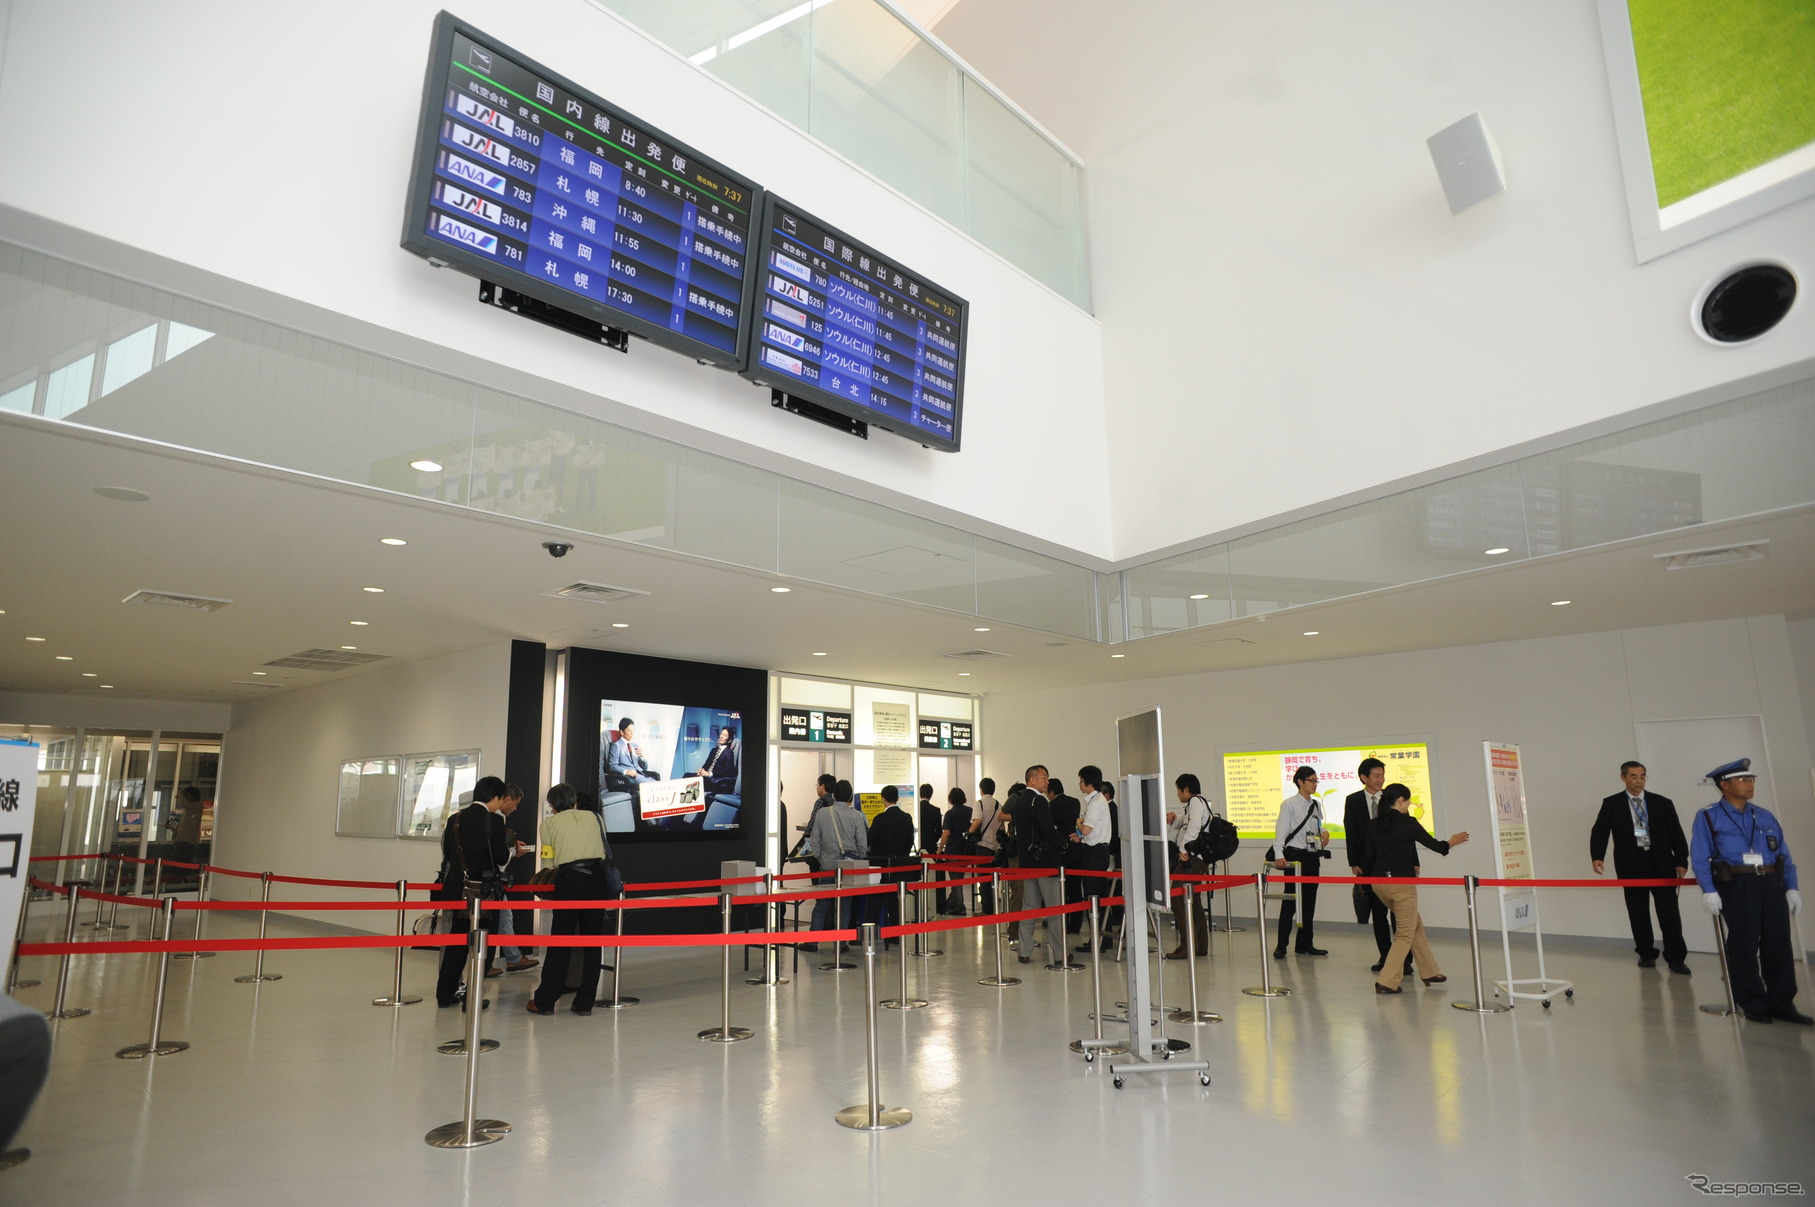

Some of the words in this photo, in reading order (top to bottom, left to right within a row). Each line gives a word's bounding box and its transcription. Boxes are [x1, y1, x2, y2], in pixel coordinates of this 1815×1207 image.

[469, 82, 509, 108] 航空会社
[518, 106, 540, 124] 便名
[564, 130, 605, 158] 行先
[625, 160, 646, 178] 定刻
[661, 179, 682, 196] 変更
[536, 81, 687, 175] 国内線出発便
[462, 133, 501, 161] JAL
[510, 152, 536, 174] 2857
[556, 174, 600, 206] 札幌
[618, 204, 643, 224] 11:30
[684, 236, 689, 246] 1
[694, 240, 740, 270] 搭乗手続中
[466, 104, 506, 132] JAL
[514, 126, 540, 146] 3810
[560, 146, 604, 179] 福岡
[625, 180, 646, 198] 8:40
[686, 211, 691, 220] 1
[697, 216, 742, 246] 搭乗手続中
[724, 186, 742, 203] 7:37
[448, 160, 486, 185] ANA
[512, 186, 532, 203] 783
[552, 202, 596, 234] 沖縄
[614, 230, 640, 251] 11:55
[680, 260, 686, 272] 1
[439, 222, 478, 245] ANA
[504, 244, 523, 262] 781
[544, 260, 589, 290] 札幌
[607, 284, 633, 305] 17:30
[674, 313, 680, 324] 1
[452, 192, 493, 217] JAL
[502, 212, 528, 234] 3814
[548, 230, 593, 262] 福岡
[610, 257, 636, 278] 14:00
[677, 286, 682, 298] 1
[688, 291, 734, 319] 搭乗手続中
[782, 242, 808, 260] 航空会社
[813, 256, 827, 270] 便名
[880, 292, 894, 304] 定刻
[824, 236, 919, 299] 国際線出発便
[779, 282, 803, 302] JAL
[808, 296, 824, 310] 5251
[828, 304, 875, 335] ソウル(仁川)
[876, 328, 892, 342] 11:45
[918, 348, 922, 356] 3
[926, 351, 954, 372] 共同運航便
[814, 274, 826, 288] 780
[830, 282, 876, 312] ソウル(仁川)
[878, 306, 894, 320] 11:45
[920, 327, 923, 335] 3
[926, 330, 956, 352] 共同運航便
[942, 304, 955, 317] 7:37
[770, 328, 792, 345] ANA
[804, 342, 821, 356] 6946
[824, 348, 872, 379] ソウル(仁川)
[872, 370, 889, 385] 12:45
[914, 390, 918, 398] 3
[922, 393, 952, 412] 共同運航便
[811, 320, 823, 333] 125
[826, 325, 873, 356] ソウル(仁川)
[874, 348, 891, 363] 12:45
[916, 368, 920, 377] 3
[924, 372, 954, 392] 共同運航便
[803, 366, 819, 380] 7533
[832, 376, 859, 397] 台北
[870, 392, 888, 407] 14:15
[913, 410, 918, 419] 3
[921, 414, 952, 434] チャーター便
[783, 715, 806, 726] 出発口
[814, 730, 820, 740] 1
[920, 725, 938, 735] 出発口
[944, 739, 949, 748] 2
[1284, 756, 1322, 764] 静岡で育ち、
[647, 794, 669, 804] class
